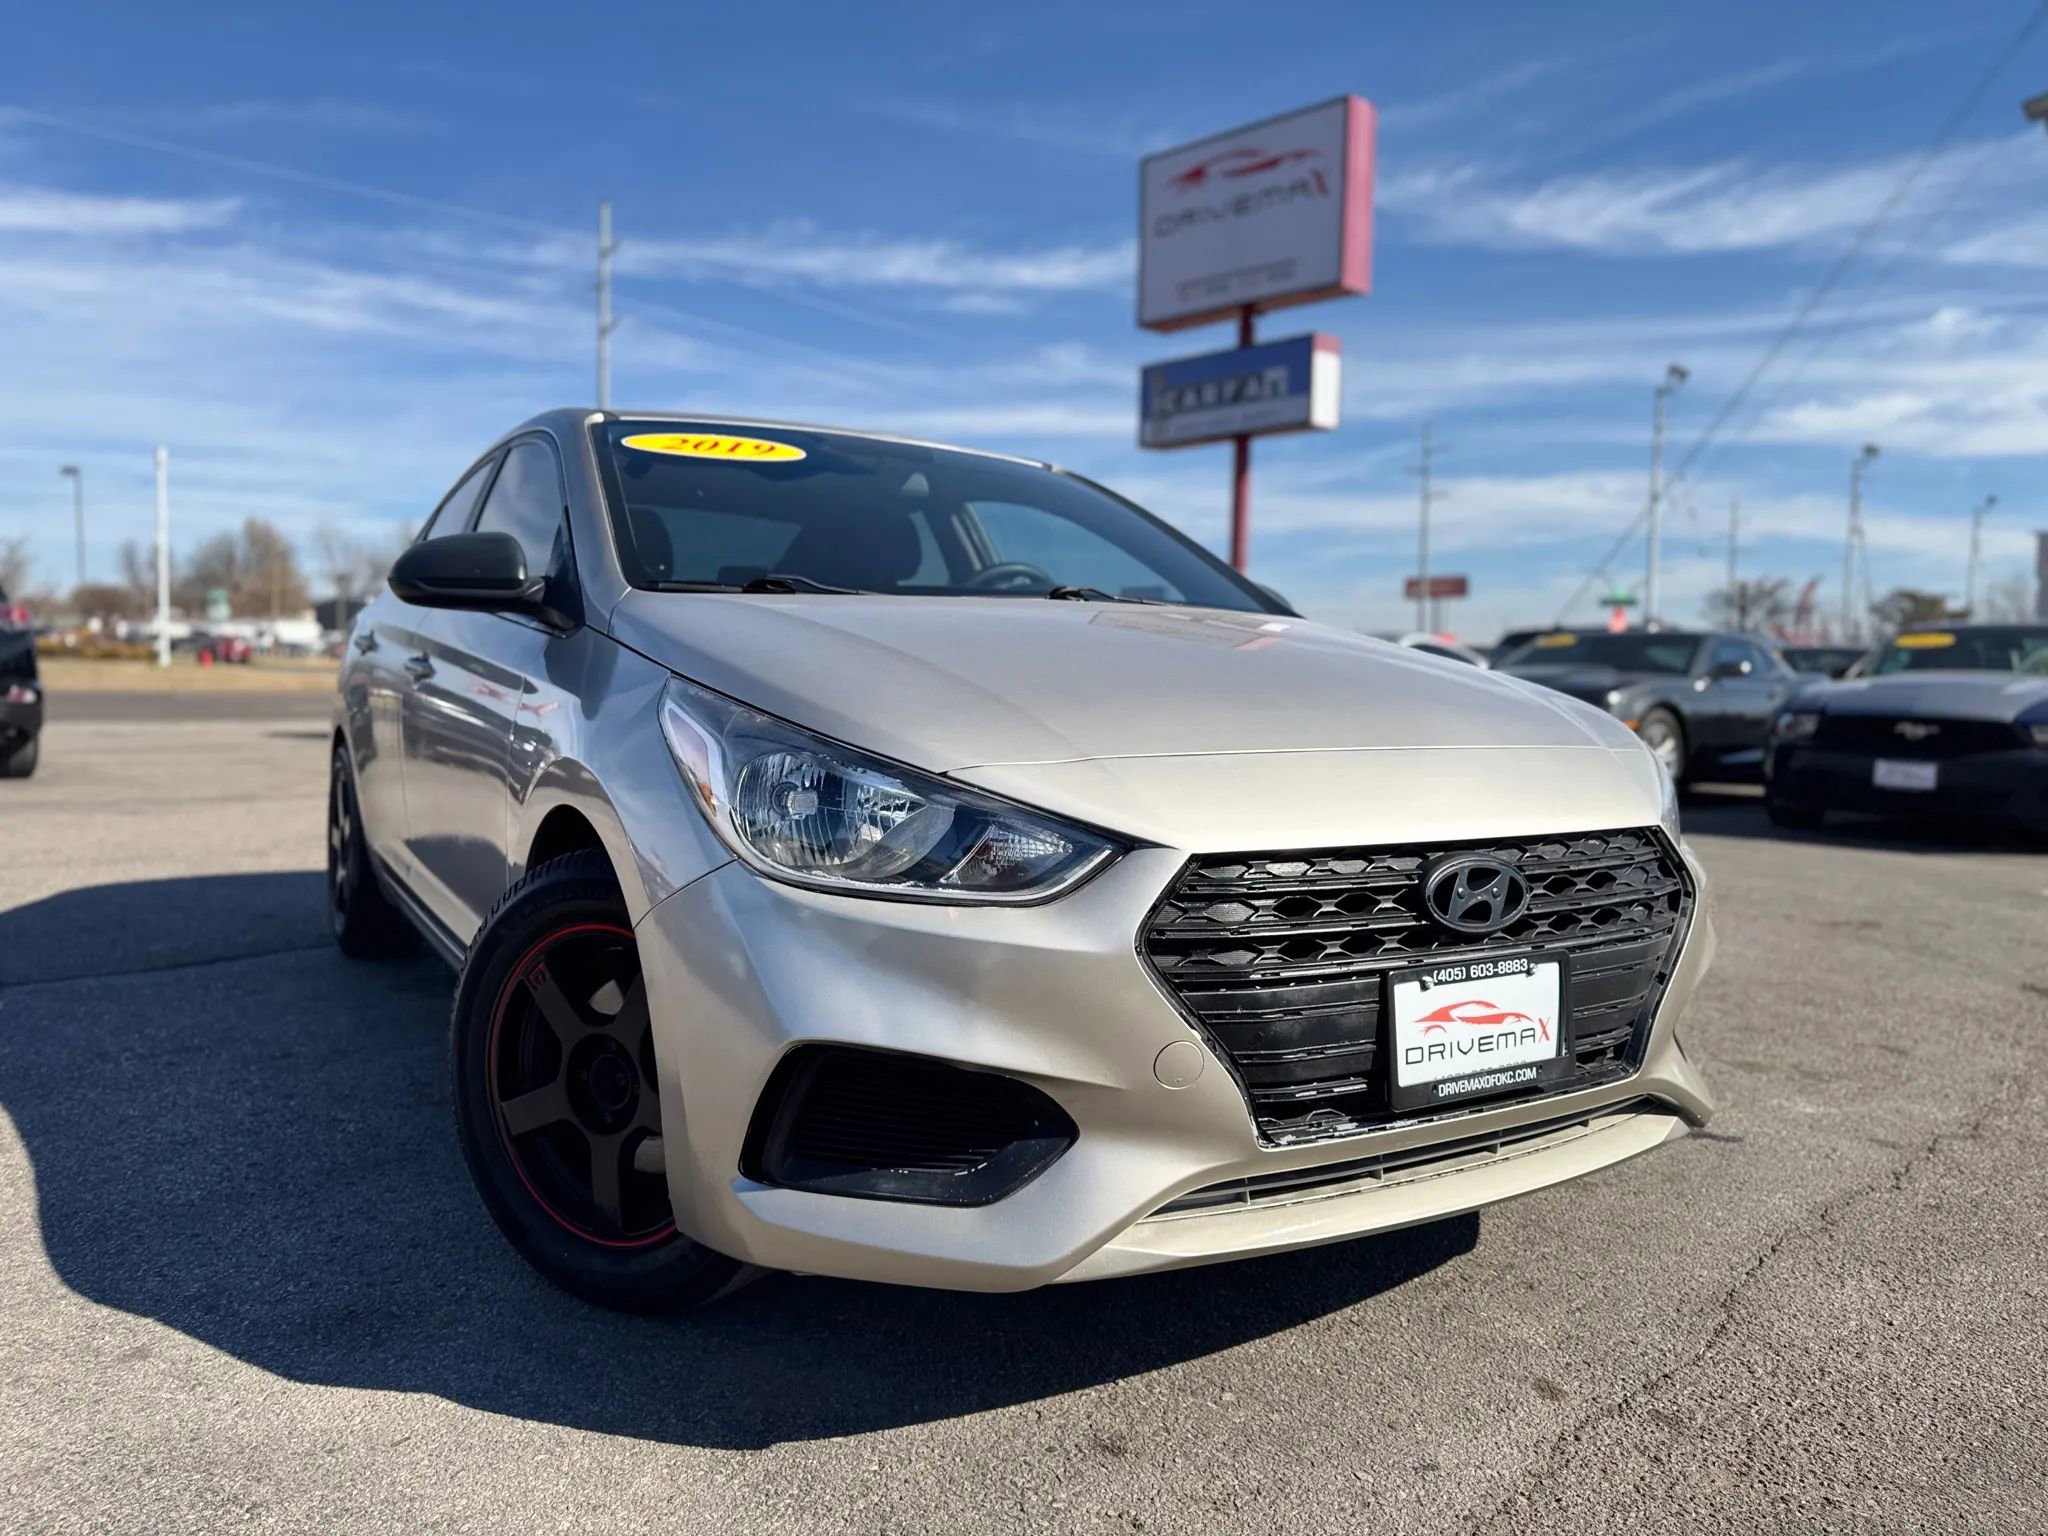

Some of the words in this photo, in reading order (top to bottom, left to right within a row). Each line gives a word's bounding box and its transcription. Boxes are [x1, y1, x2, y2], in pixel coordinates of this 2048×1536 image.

[661, 438, 776, 455] 2019
[1433, 966, 1467, 983] (405)
[1470, 958, 1528, 978] 603-8883
[1405, 1016, 1550, 1065] DRIVEMAX
[1438, 1067, 1537, 1097] DRIVEMAXOFOKC.COM
